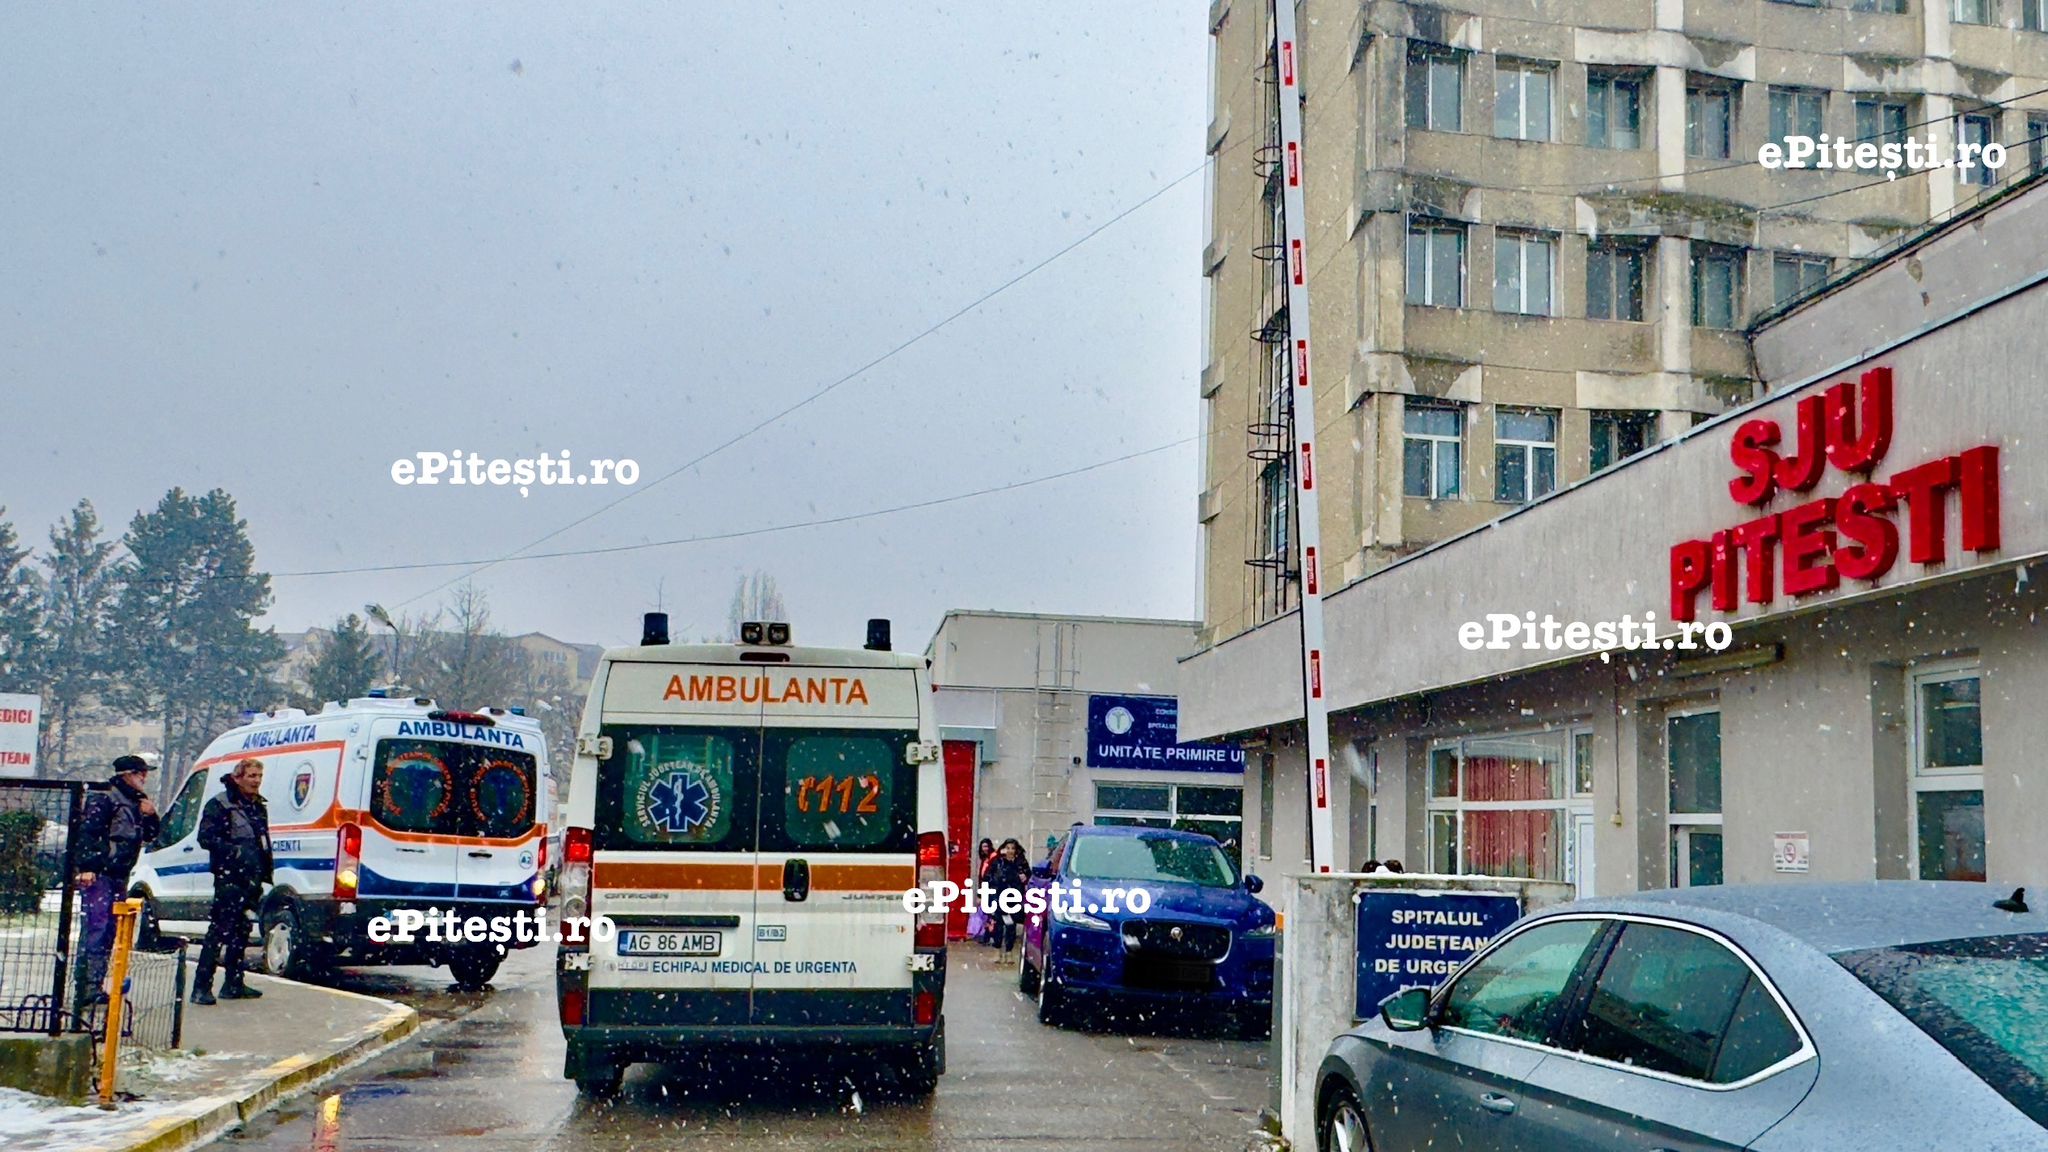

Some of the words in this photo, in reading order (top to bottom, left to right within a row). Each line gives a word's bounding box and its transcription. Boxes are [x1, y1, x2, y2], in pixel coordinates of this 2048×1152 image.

[1729, 367, 1893, 505] SJU
[1671, 445, 2000, 621] PITESTI
[663, 674, 869, 705] AMBULANTA
[242, 724, 317, 750] AMBULANTA
[398, 721, 524, 748] AMBULANTA
[1100, 745, 1162, 759] UNITATE
[1166, 748, 1226, 762] PRIMIRE
[636, 780, 652, 828] SERVICIUL
[272, 840, 301, 852] CIENTI
[1391, 909, 1484, 927] SPITALUL
[628, 935, 651, 951] AG
[657, 935, 678, 951] 86
[681, 935, 716, 951] AMB
[652, 961, 708, 974] ECHIPAJ
[711, 961, 770, 974] MEDICAL
[773, 961, 792, 974] DE
[795, 961, 858, 975] URGENTA
[1374, 958, 1401, 973] DE
[1406, 959, 1463, 975] URGE
